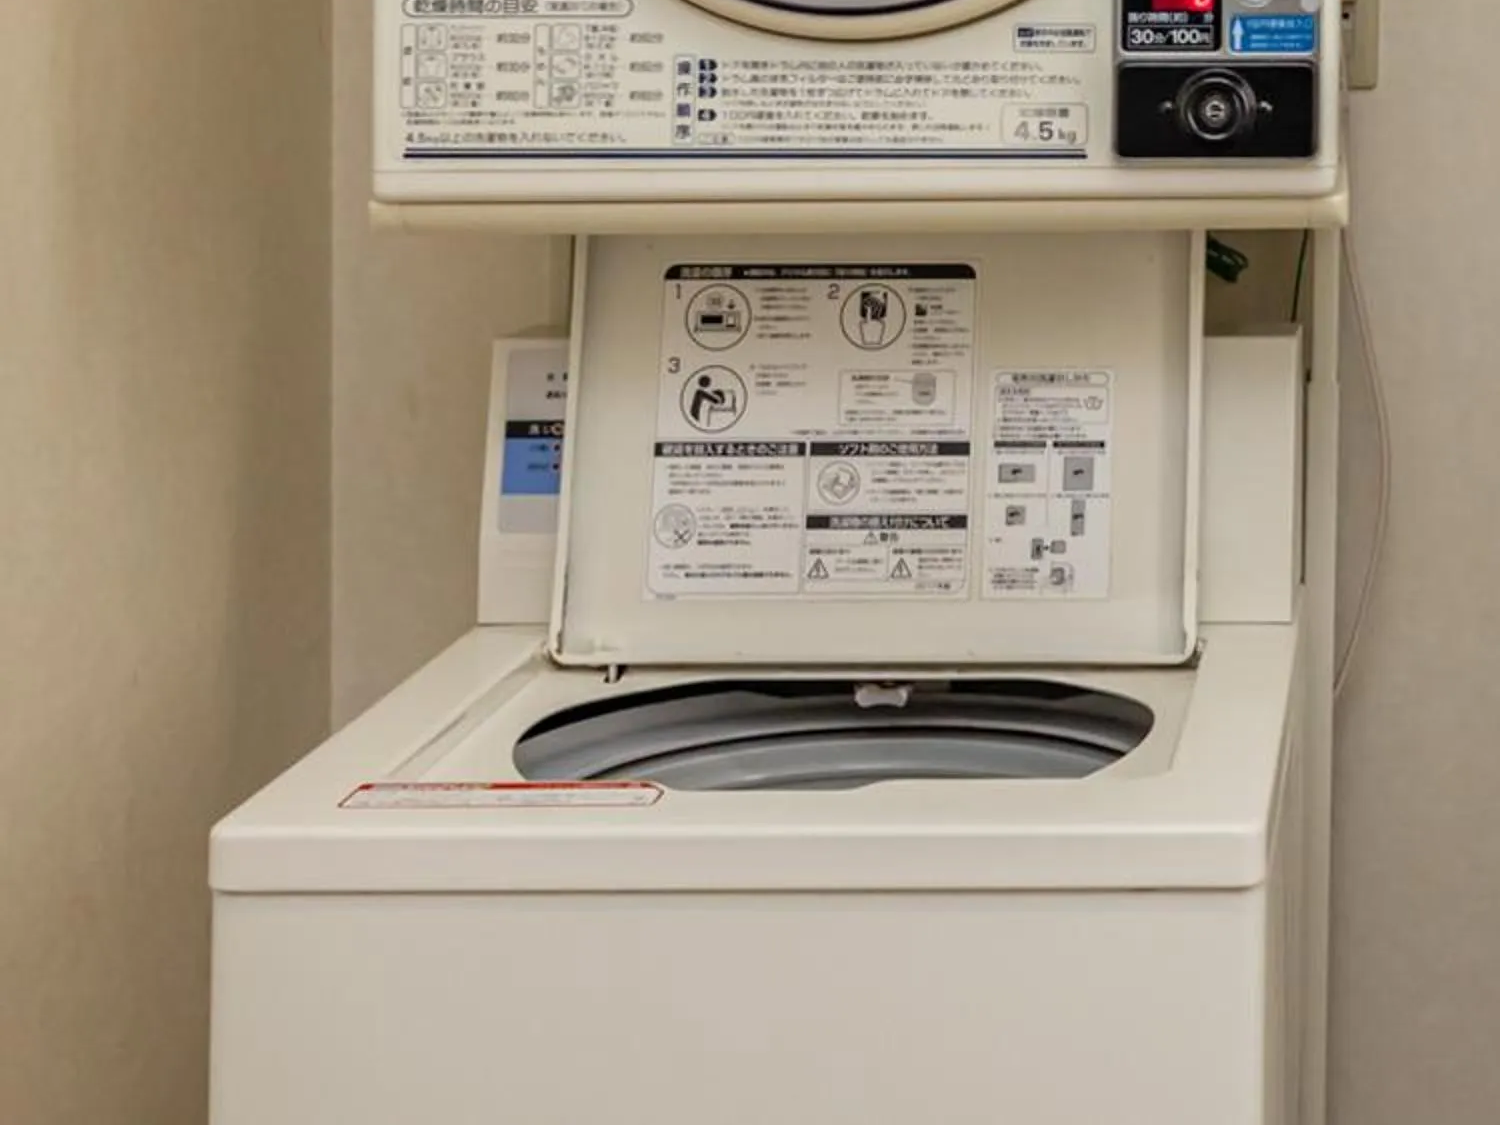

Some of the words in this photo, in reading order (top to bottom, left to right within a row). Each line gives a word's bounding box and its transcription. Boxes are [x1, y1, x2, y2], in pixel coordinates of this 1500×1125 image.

[674, 283, 683, 300] 1
[827, 283, 840, 300] 2
[667, 357, 681, 374] 3
